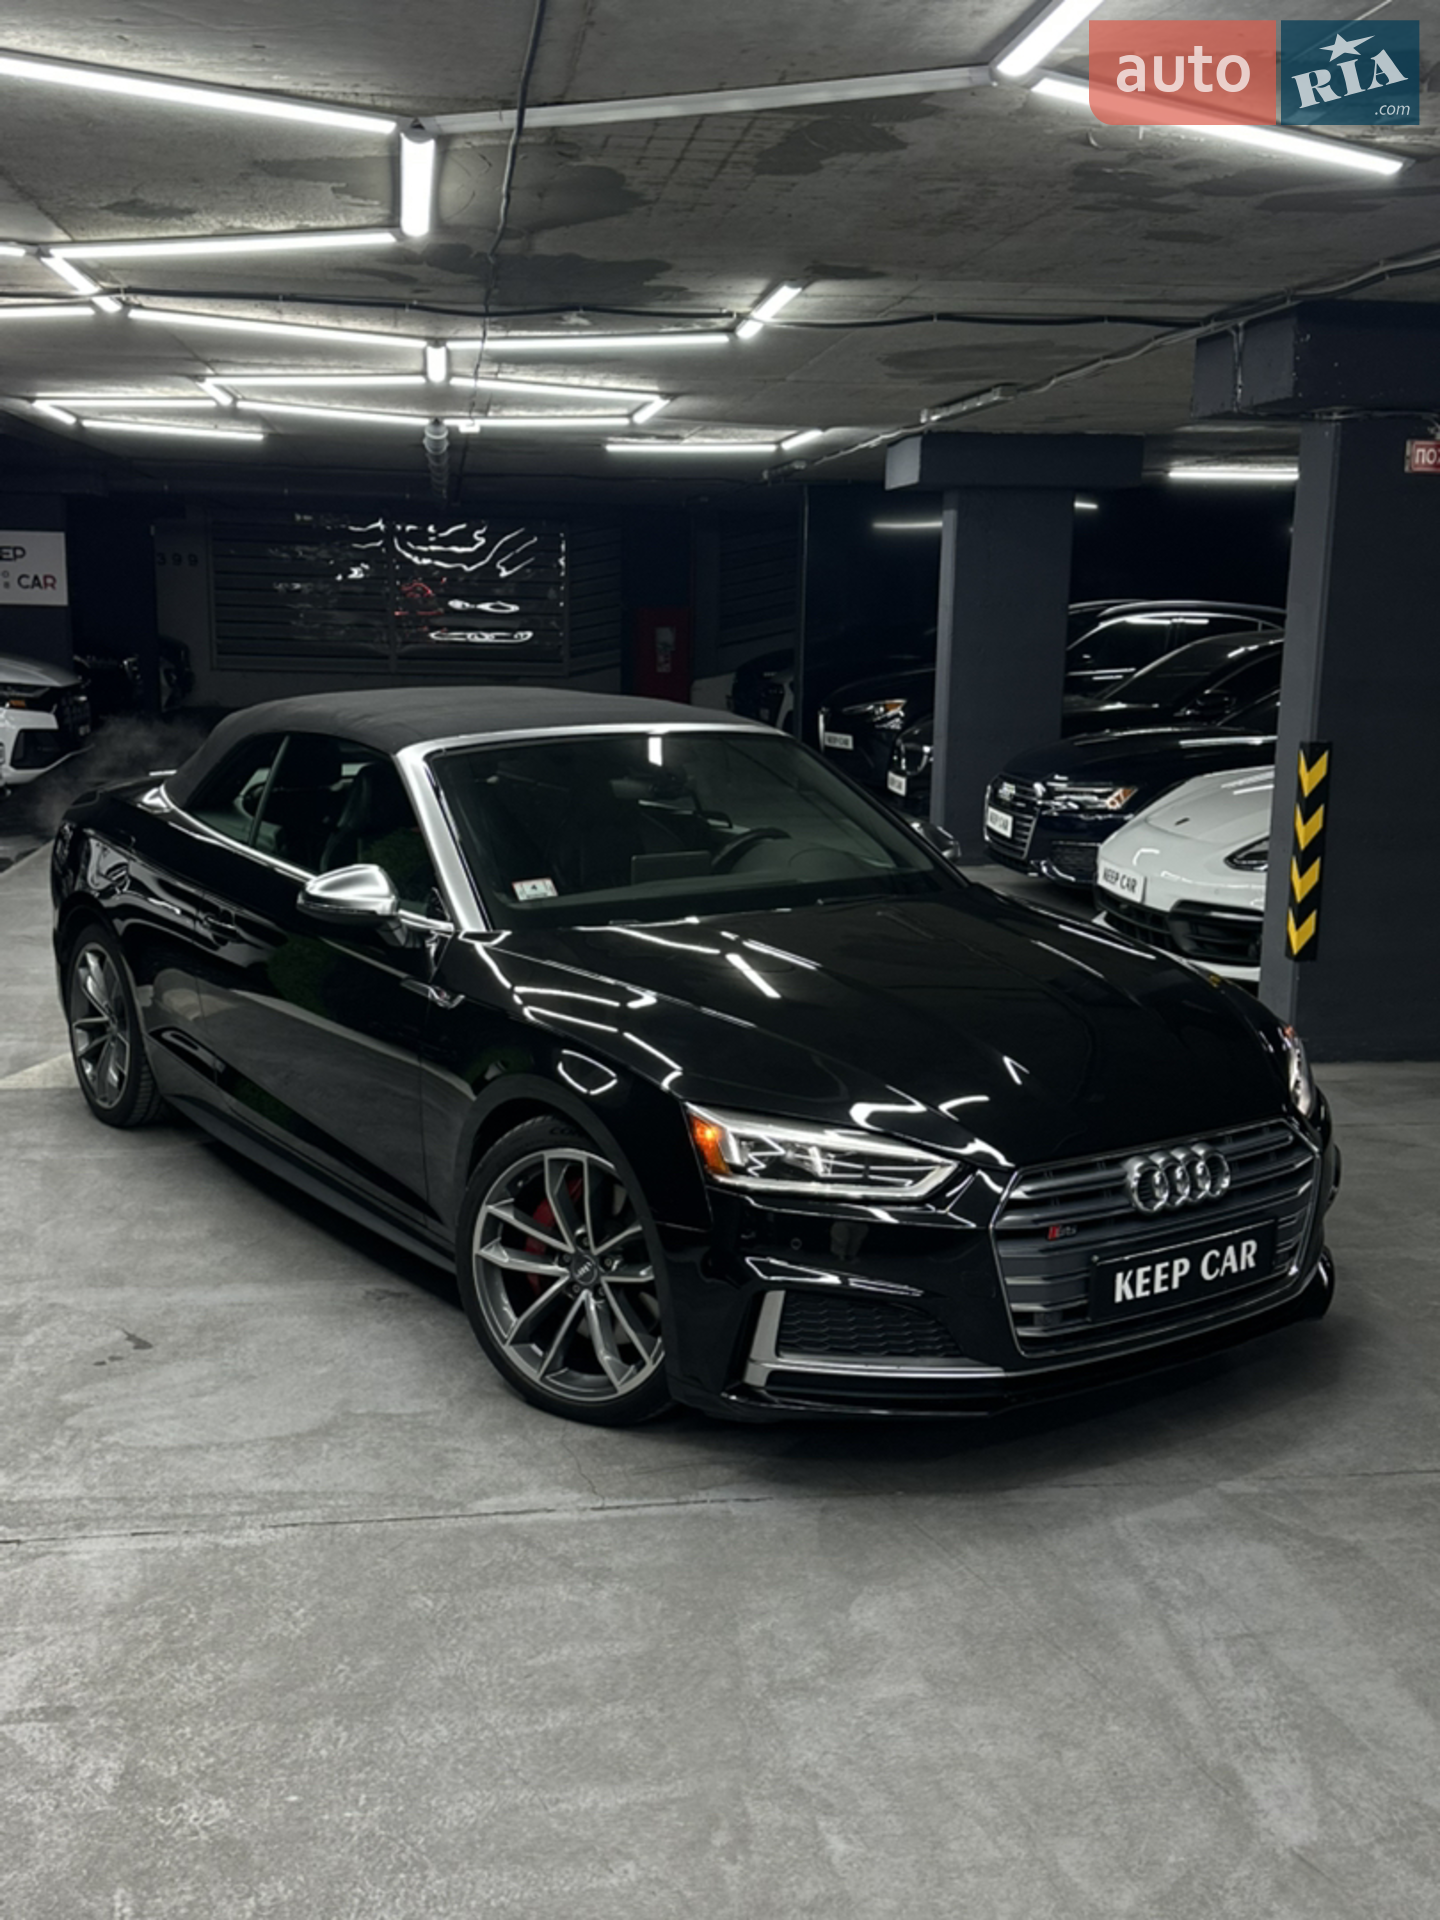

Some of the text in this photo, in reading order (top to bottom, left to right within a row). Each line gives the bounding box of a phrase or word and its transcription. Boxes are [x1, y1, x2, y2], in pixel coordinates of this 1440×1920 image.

[17, 573, 58, 590] CAR
[1120, 874, 1137, 894] CAR
[1114, 1239, 1258, 1304] KEEP CAR
